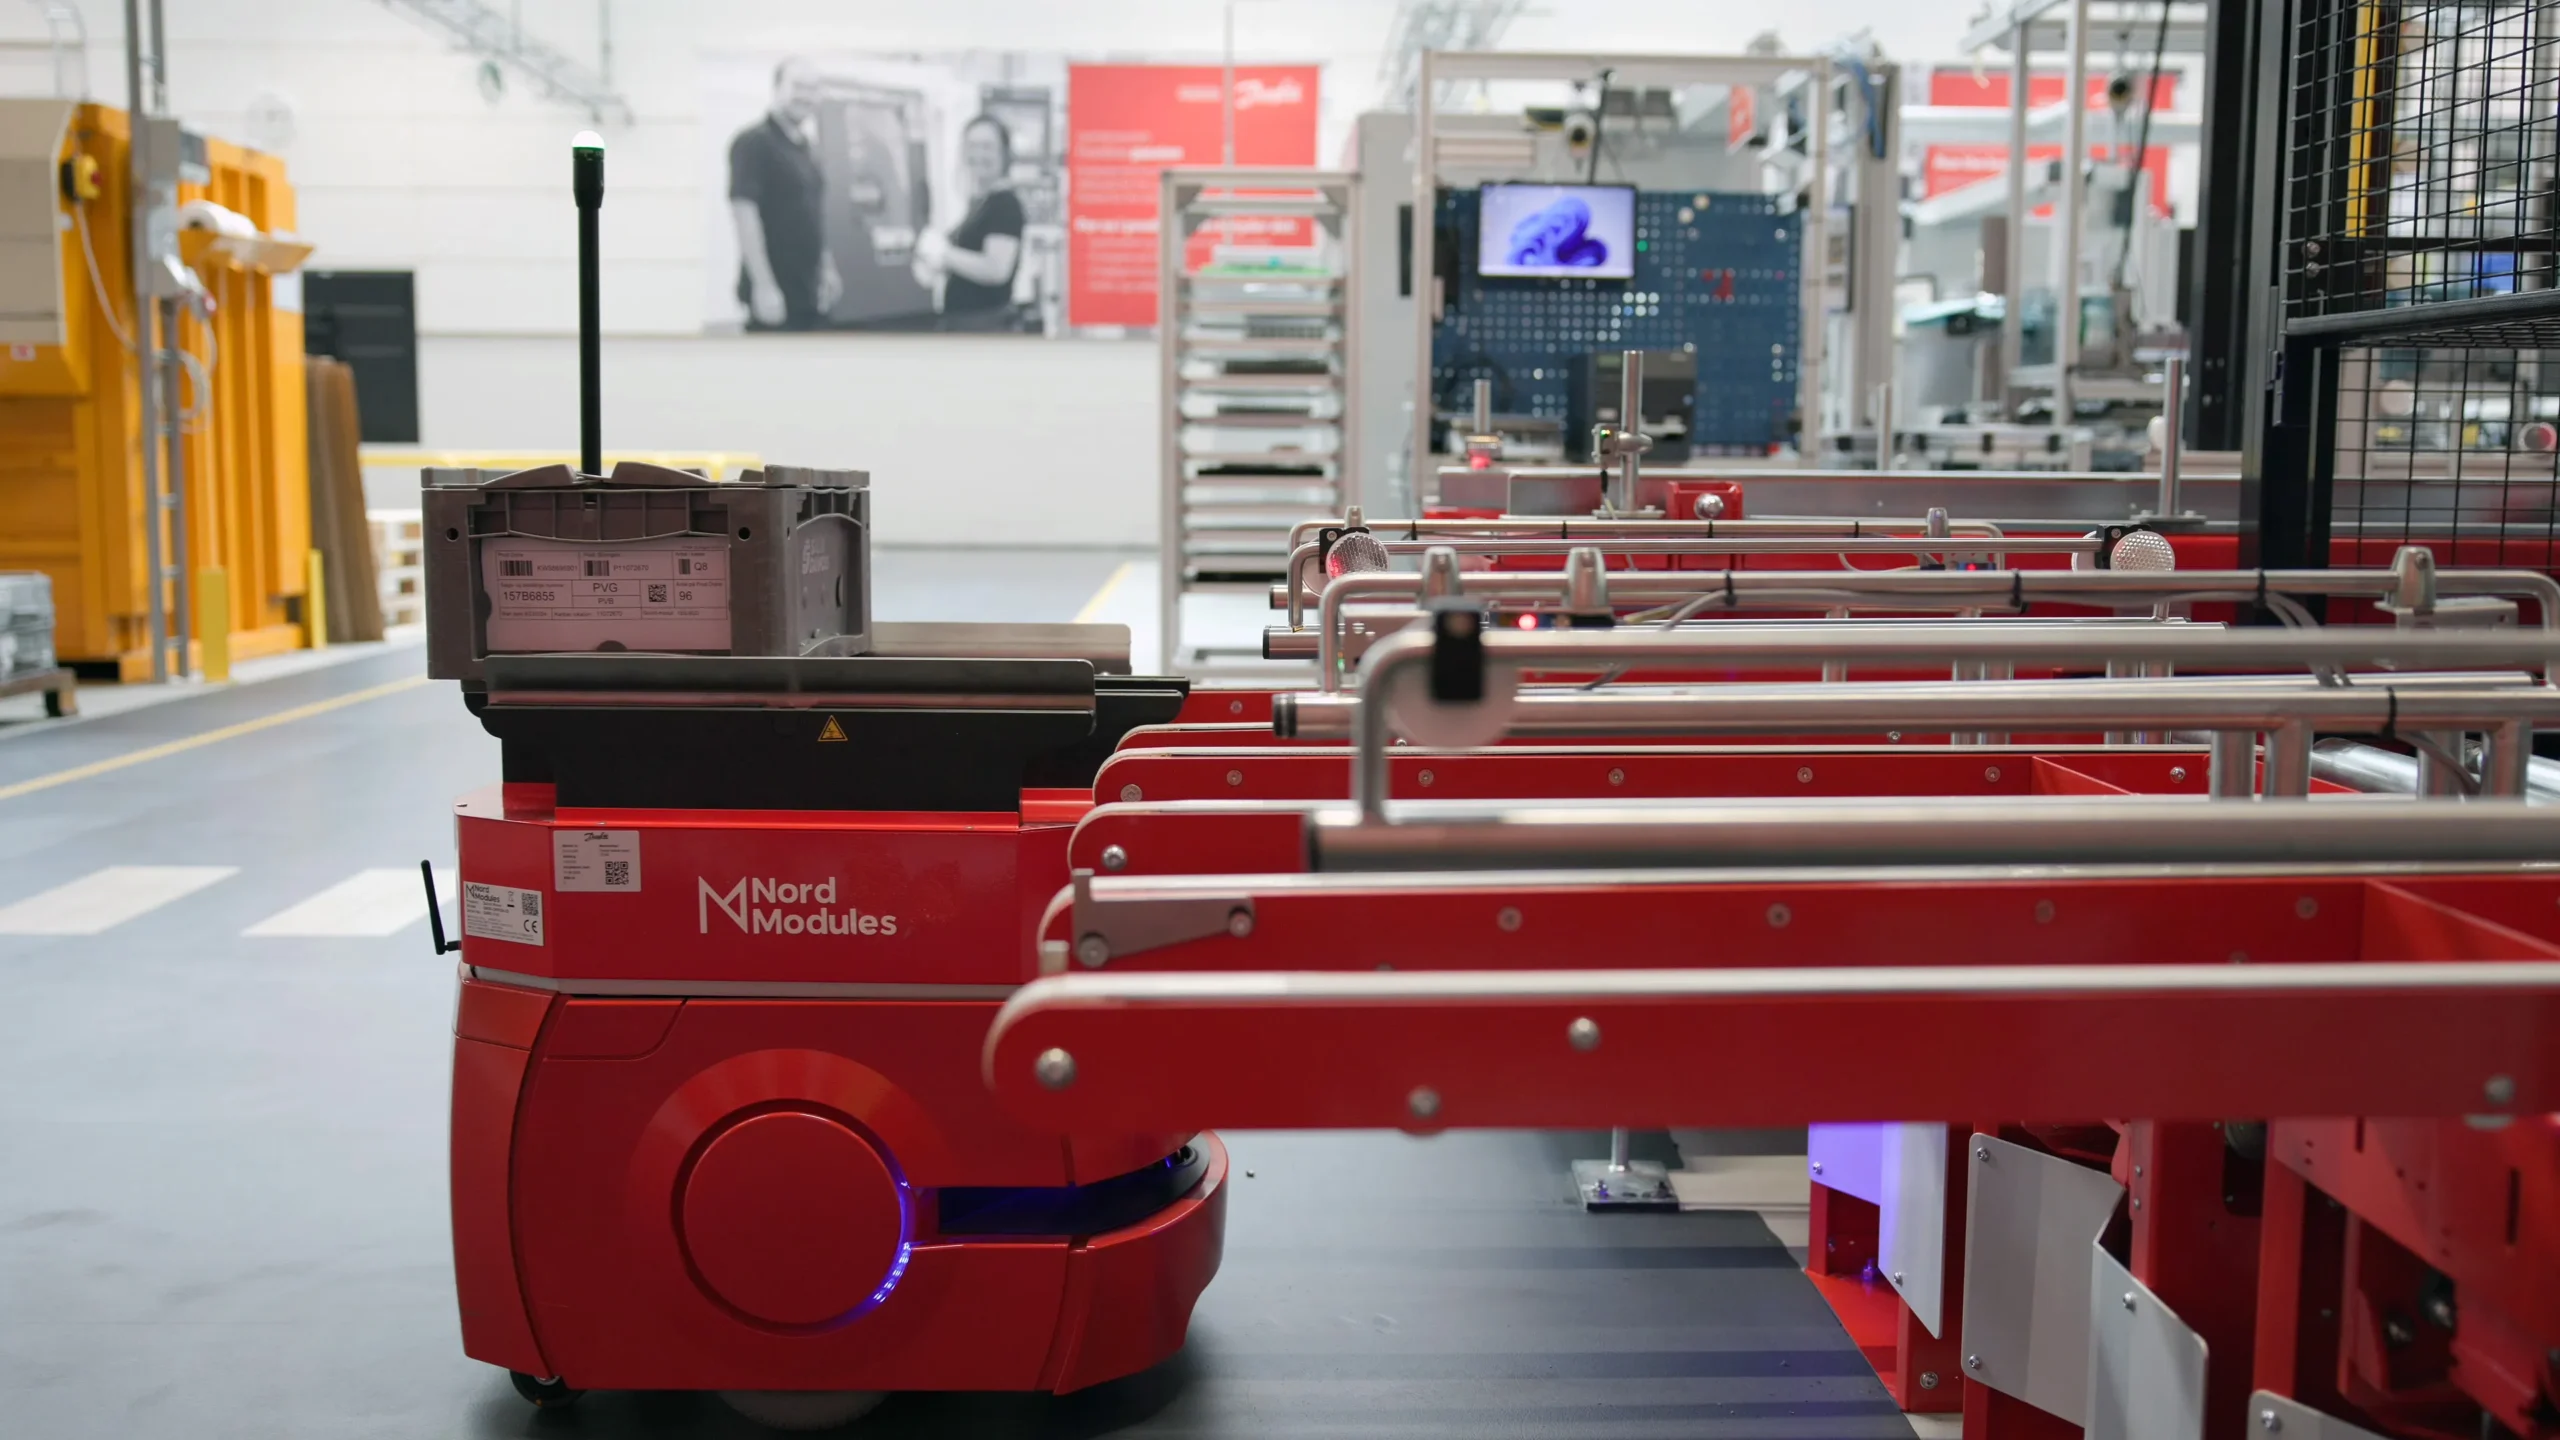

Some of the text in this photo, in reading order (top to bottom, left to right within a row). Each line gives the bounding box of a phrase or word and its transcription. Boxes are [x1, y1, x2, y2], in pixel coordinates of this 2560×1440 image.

[592, 582, 618, 593] PVG
[503, 591, 555, 601] 157B6855
[679, 591, 692, 601] 96
[474, 885, 490, 893] Nord
[752, 876, 836, 904] Nord
[474, 892, 500, 903] Modules
[752, 907, 897, 935] Modules
